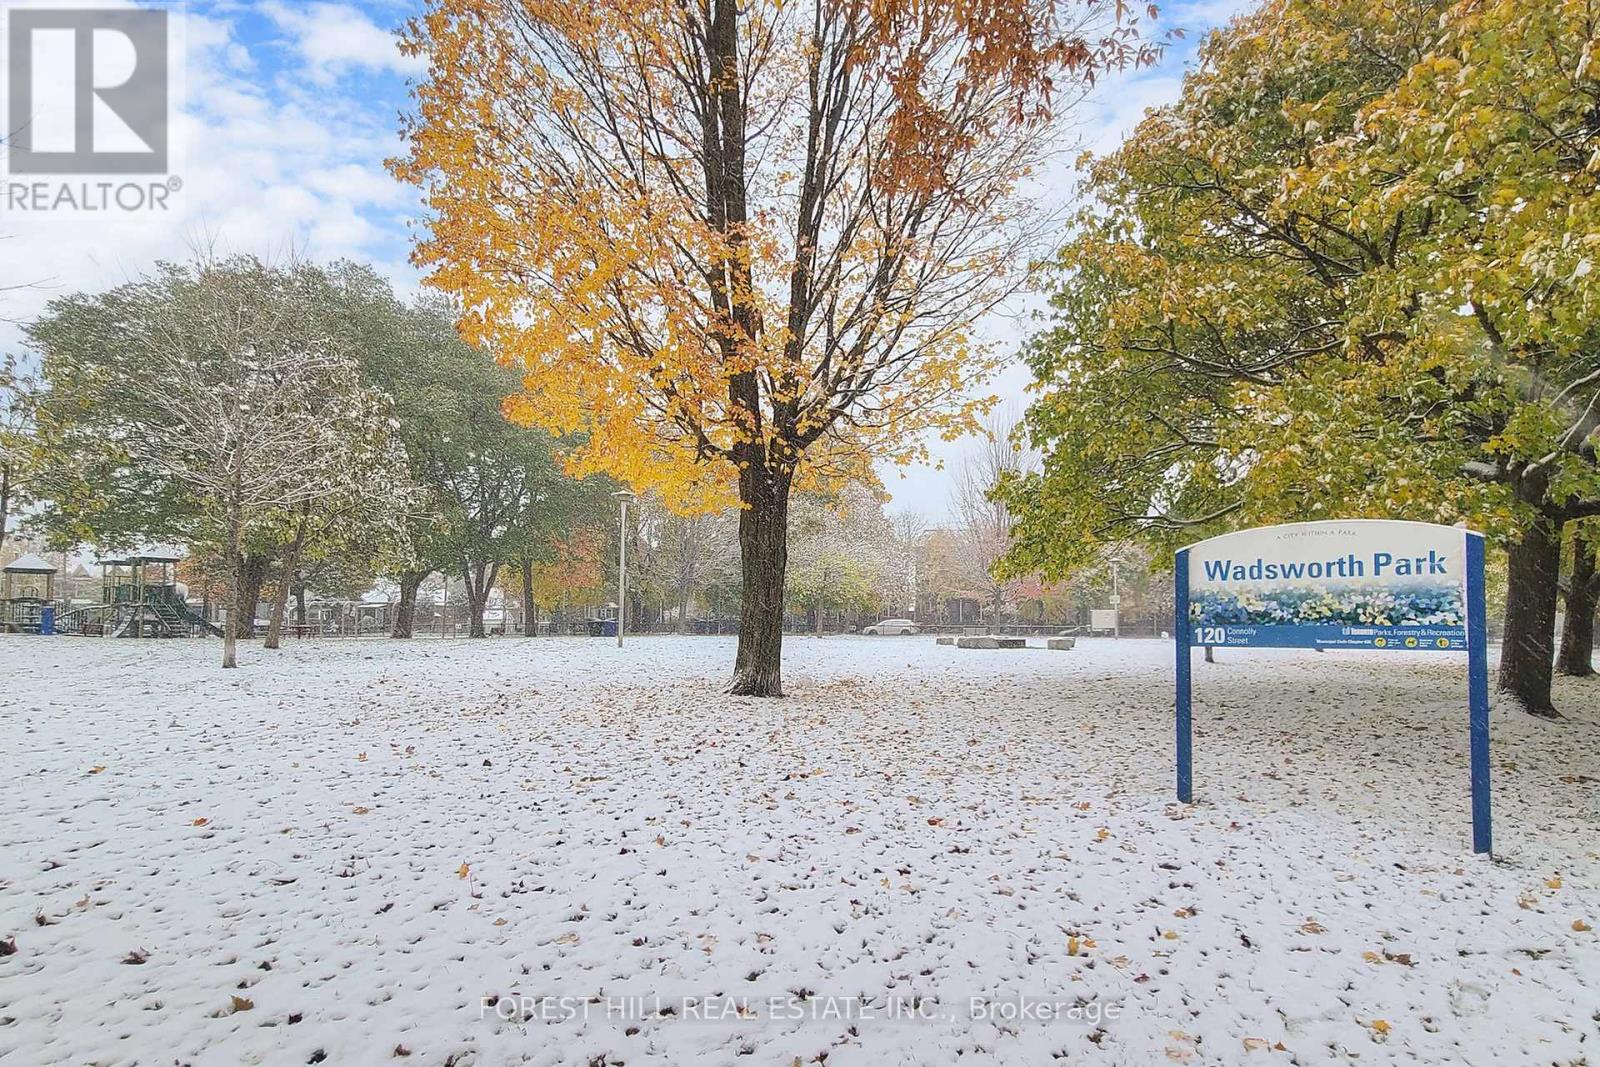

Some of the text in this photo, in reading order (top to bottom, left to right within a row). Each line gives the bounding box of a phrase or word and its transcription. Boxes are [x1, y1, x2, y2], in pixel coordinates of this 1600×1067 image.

[1283, 532, 1298, 540] CITY
[1338, 528, 1357, 536] PARK
[1203, 550, 1448, 582] Wadsworth Park
[1194, 627, 1257, 644] 120 Connolly
[1393, 629, 1420, 637] Forestry
[1420, 629, 1427, 637] &
[1427, 629, 1465, 637] Recreation
[1226, 636, 1249, 645] Street
